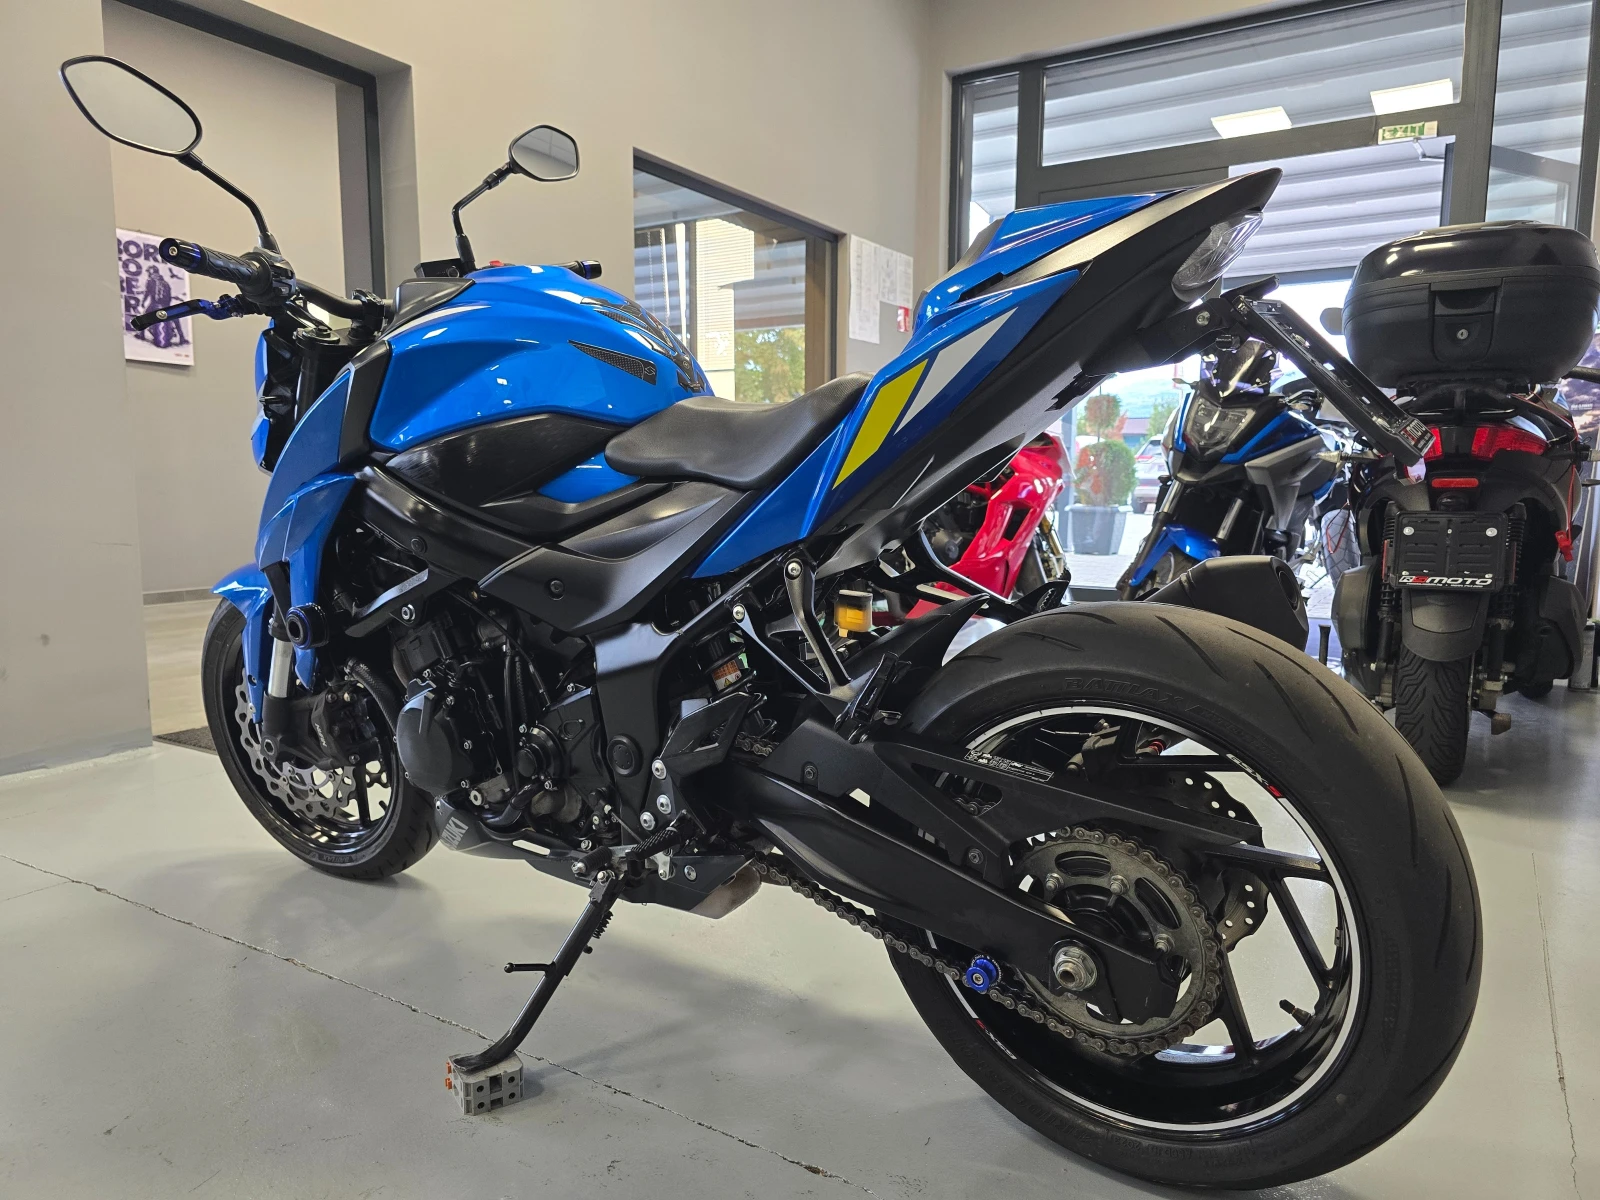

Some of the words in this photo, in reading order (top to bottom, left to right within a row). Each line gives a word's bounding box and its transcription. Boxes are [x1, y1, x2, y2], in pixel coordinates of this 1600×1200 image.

[1384, 123, 1423, 139] EXIT
[116, 238, 168, 264] OR
[118, 257, 143, 277] O
